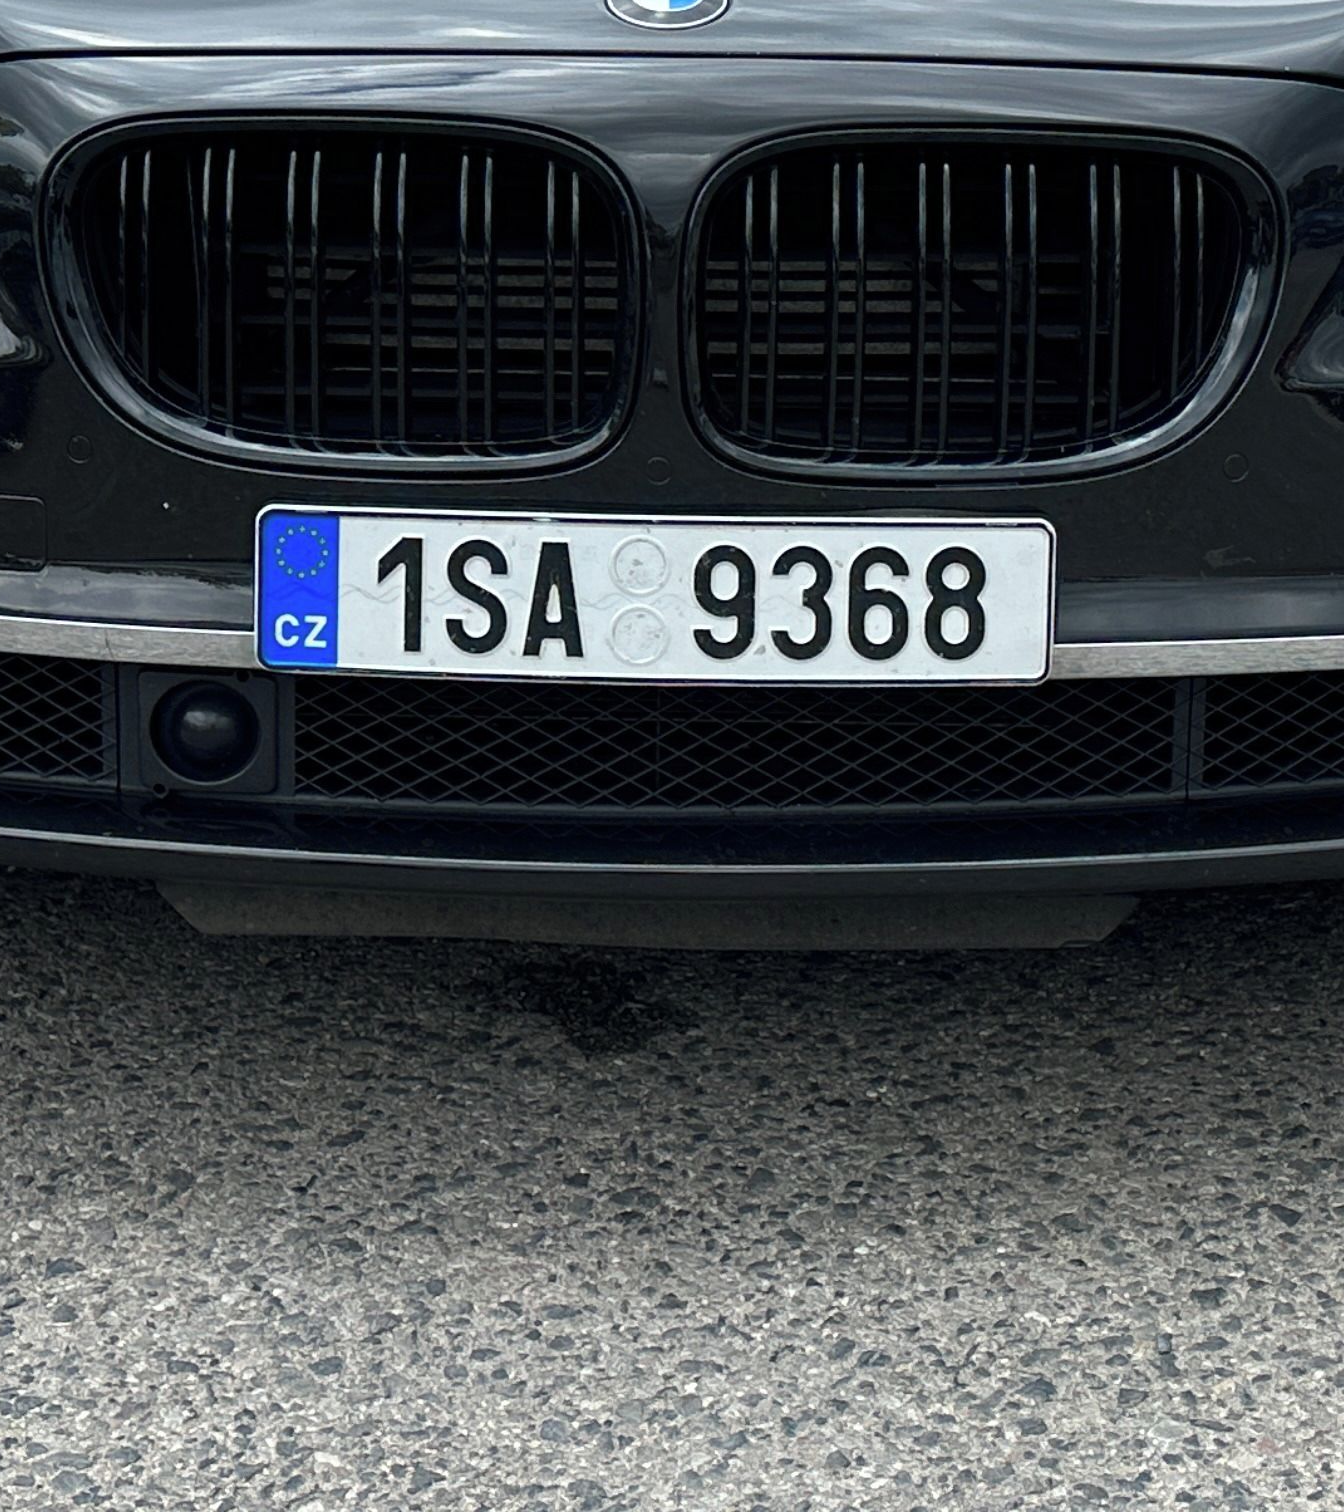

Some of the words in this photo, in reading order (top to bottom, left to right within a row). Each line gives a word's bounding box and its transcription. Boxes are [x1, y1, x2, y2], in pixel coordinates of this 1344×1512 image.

[273, 613, 328, 649] CZ
[377, 536, 585, 659] 1SA
[692, 544, 987, 662] 9368
